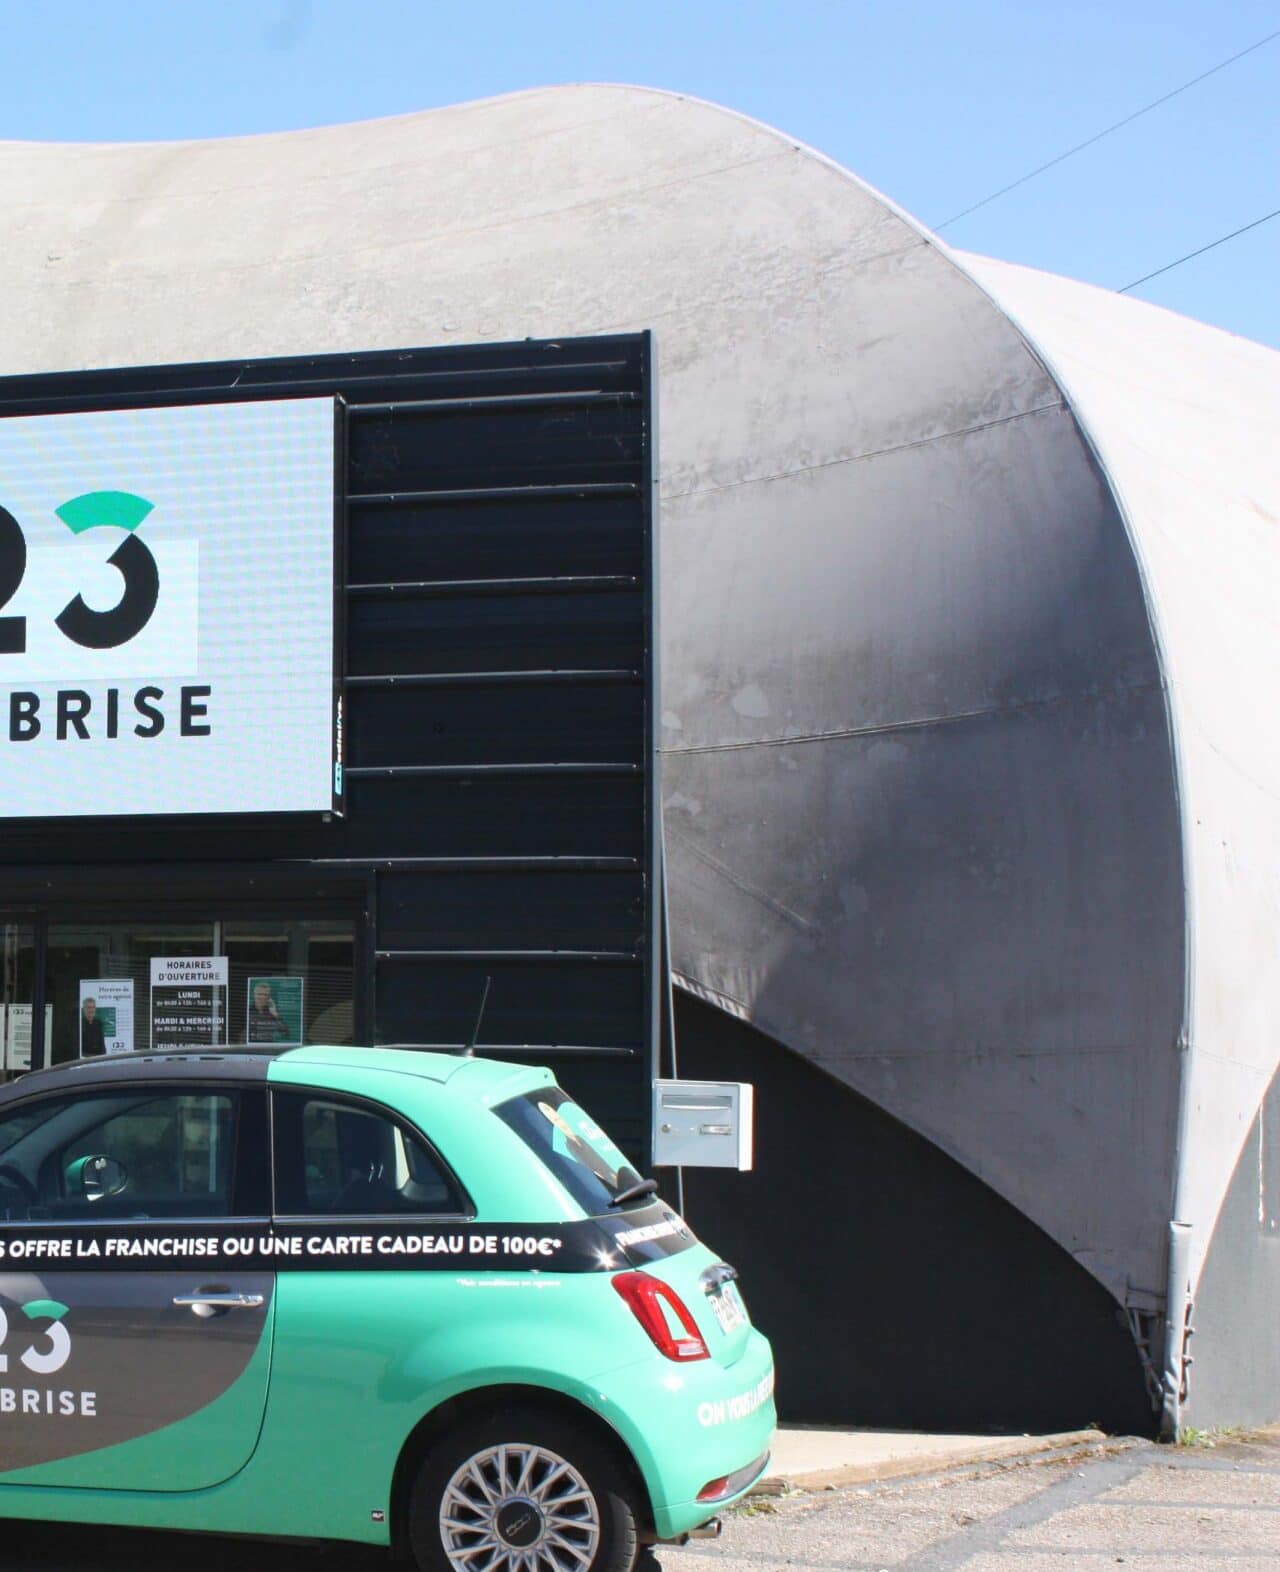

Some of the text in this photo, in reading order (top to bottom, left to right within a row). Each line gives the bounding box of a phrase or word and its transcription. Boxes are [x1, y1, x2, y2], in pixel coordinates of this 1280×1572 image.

[167, 961, 212, 969] HORAIRES
[158, 973, 224, 981] D'OUVERTURE
[177, 991, 201, 999] LUNDI
[9, 1239, 73, 1258] OFFRE
[76, 1239, 101, 1257] LA
[105, 1238, 219, 1256] FRANCHISE
[222, 1237, 254, 1255] OU
[259, 1237, 303, 1255] UNE
[306, 1236, 373, 1255] CARTE
[376, 1236, 464, 1254] CADEAU
[469, 1236, 498, 1254] DE
